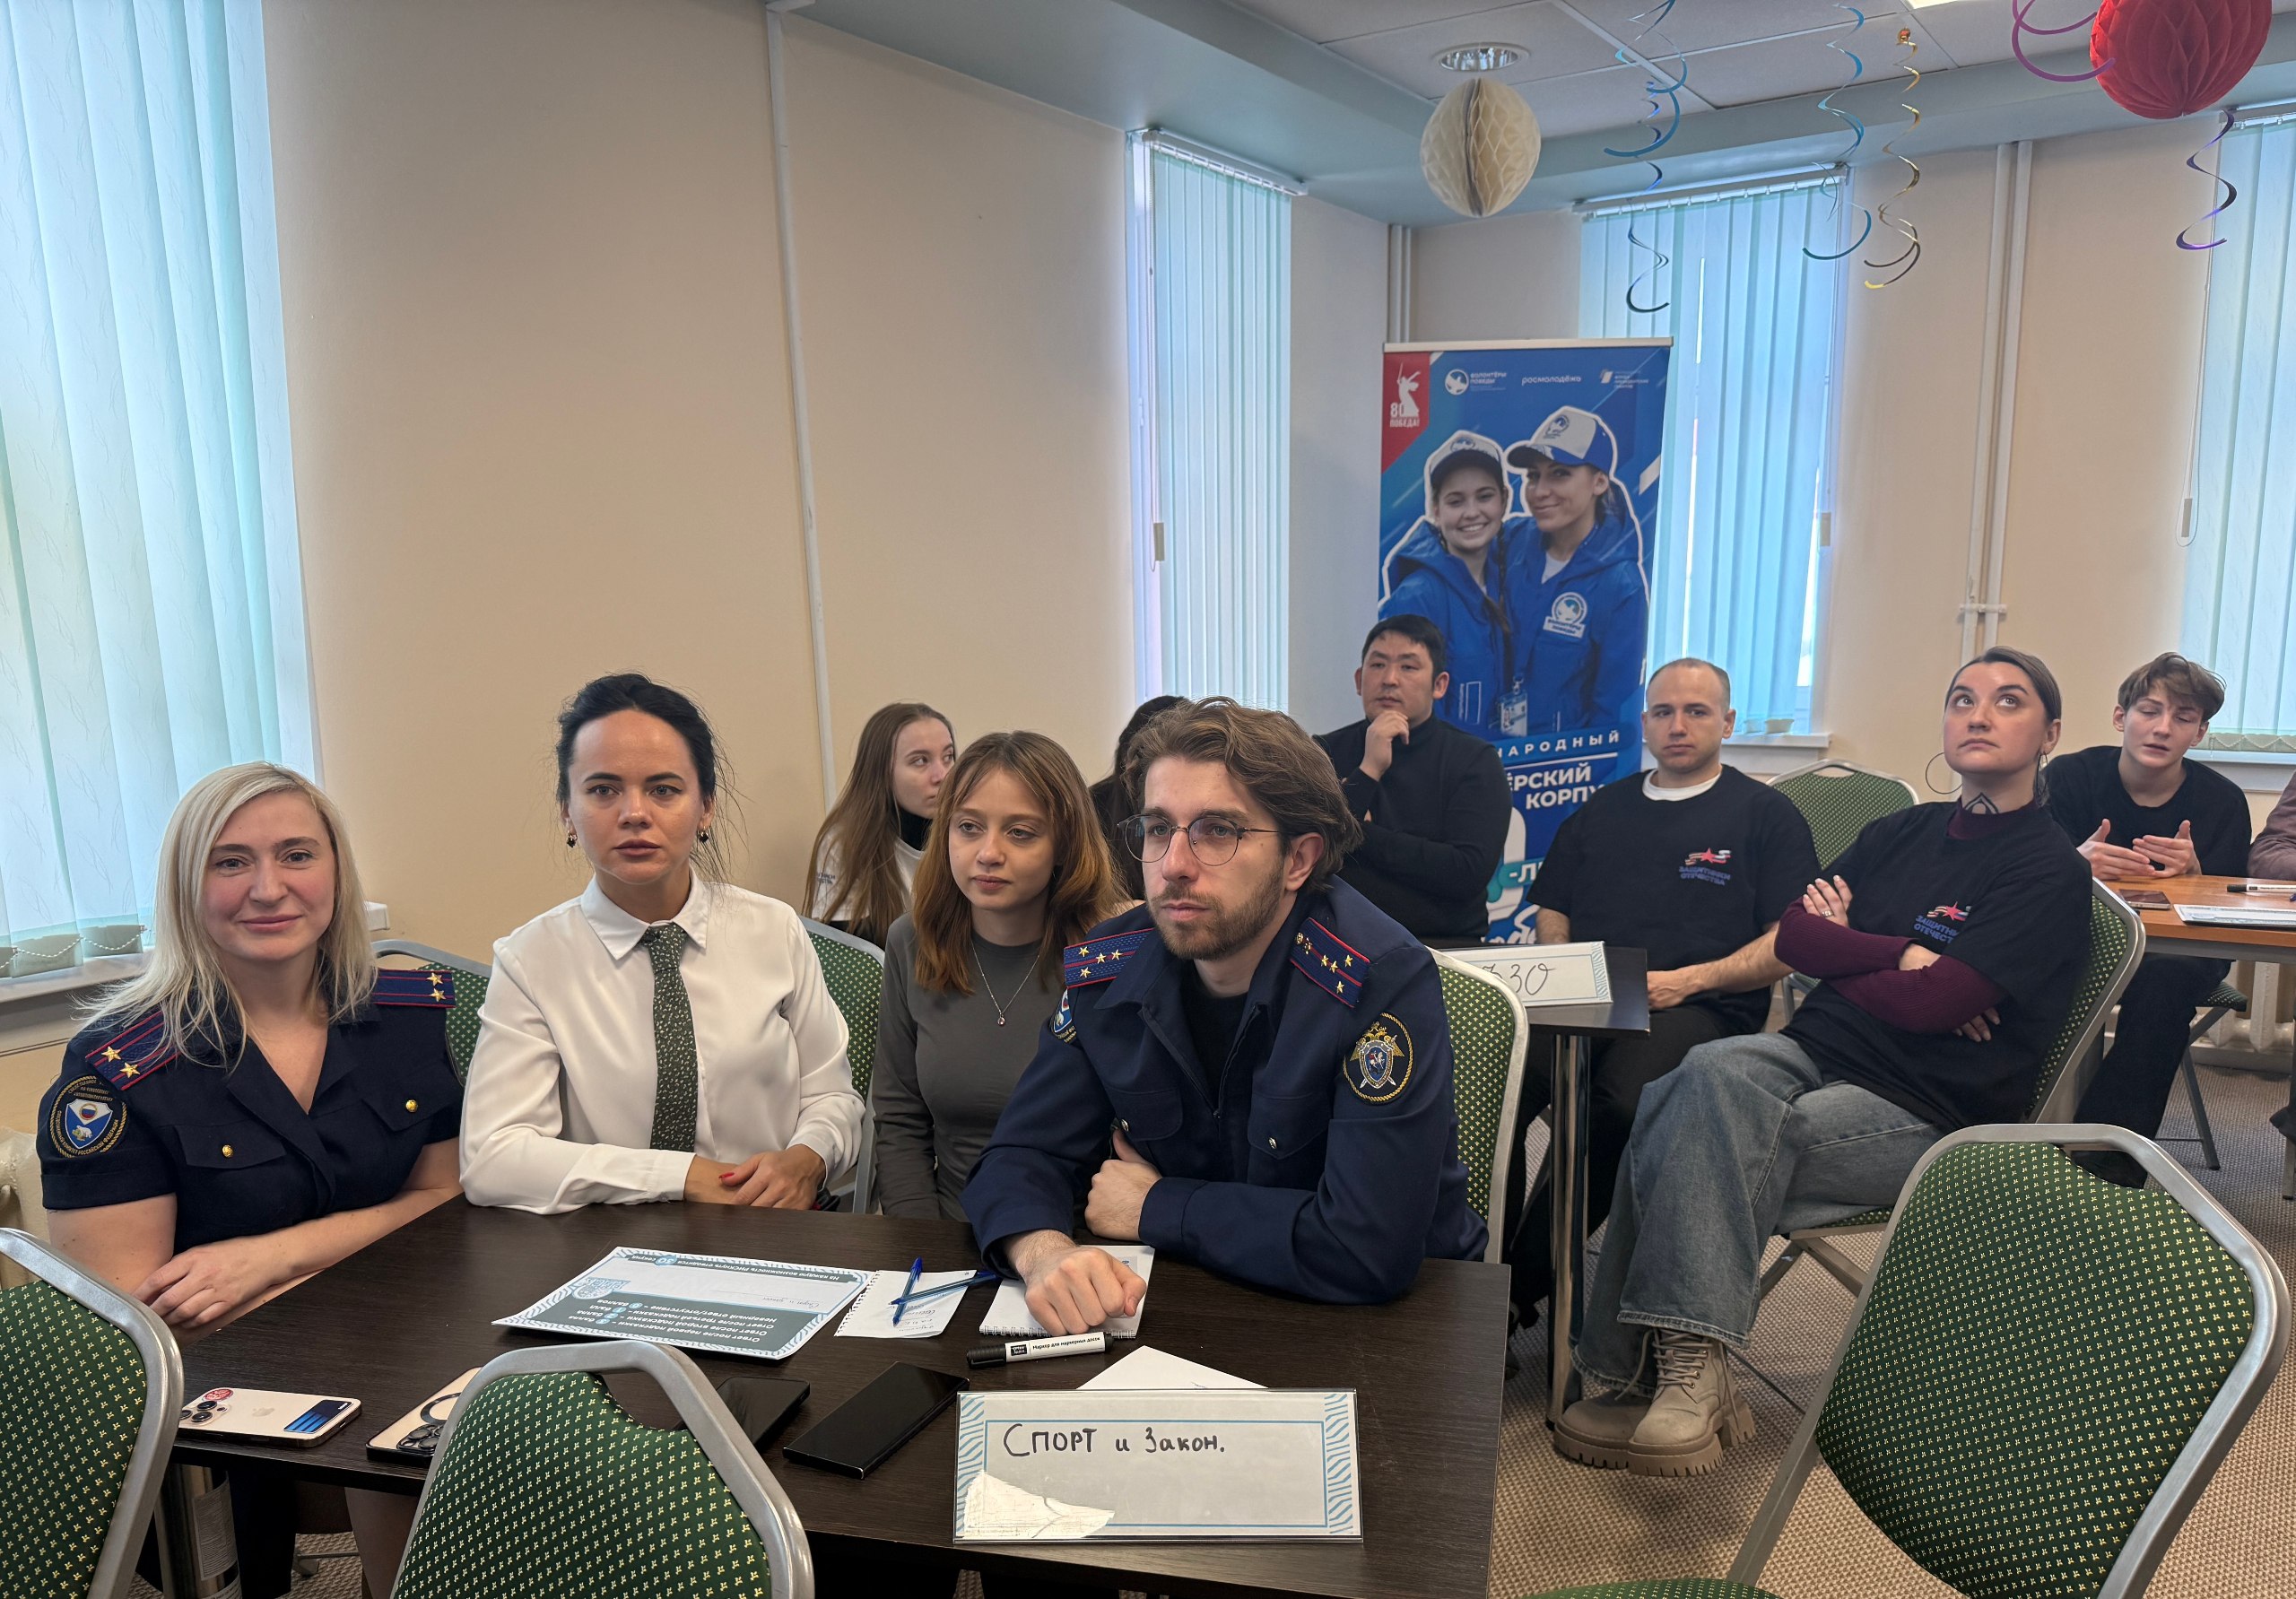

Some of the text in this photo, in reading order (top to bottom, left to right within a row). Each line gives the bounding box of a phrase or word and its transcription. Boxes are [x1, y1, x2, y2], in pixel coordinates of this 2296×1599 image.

[1509, 861, 1544, 883] -Л
[751, 1268, 798, 1276] возможность
[596, 1299, 630, 1307] баллов
[626, 1316, 674, 1325] подсказки
[680, 1315, 717, 1323] третьей
[729, 1314, 778, 1323] Неверный
[617, 1321, 666, 1331] подсказки
[666, 1327, 702, 1335] первой
[702, 1331, 732, 1339] после
[1115, 1437, 1131, 1452] и
[1144, 1427, 1226, 1454] Закон.
